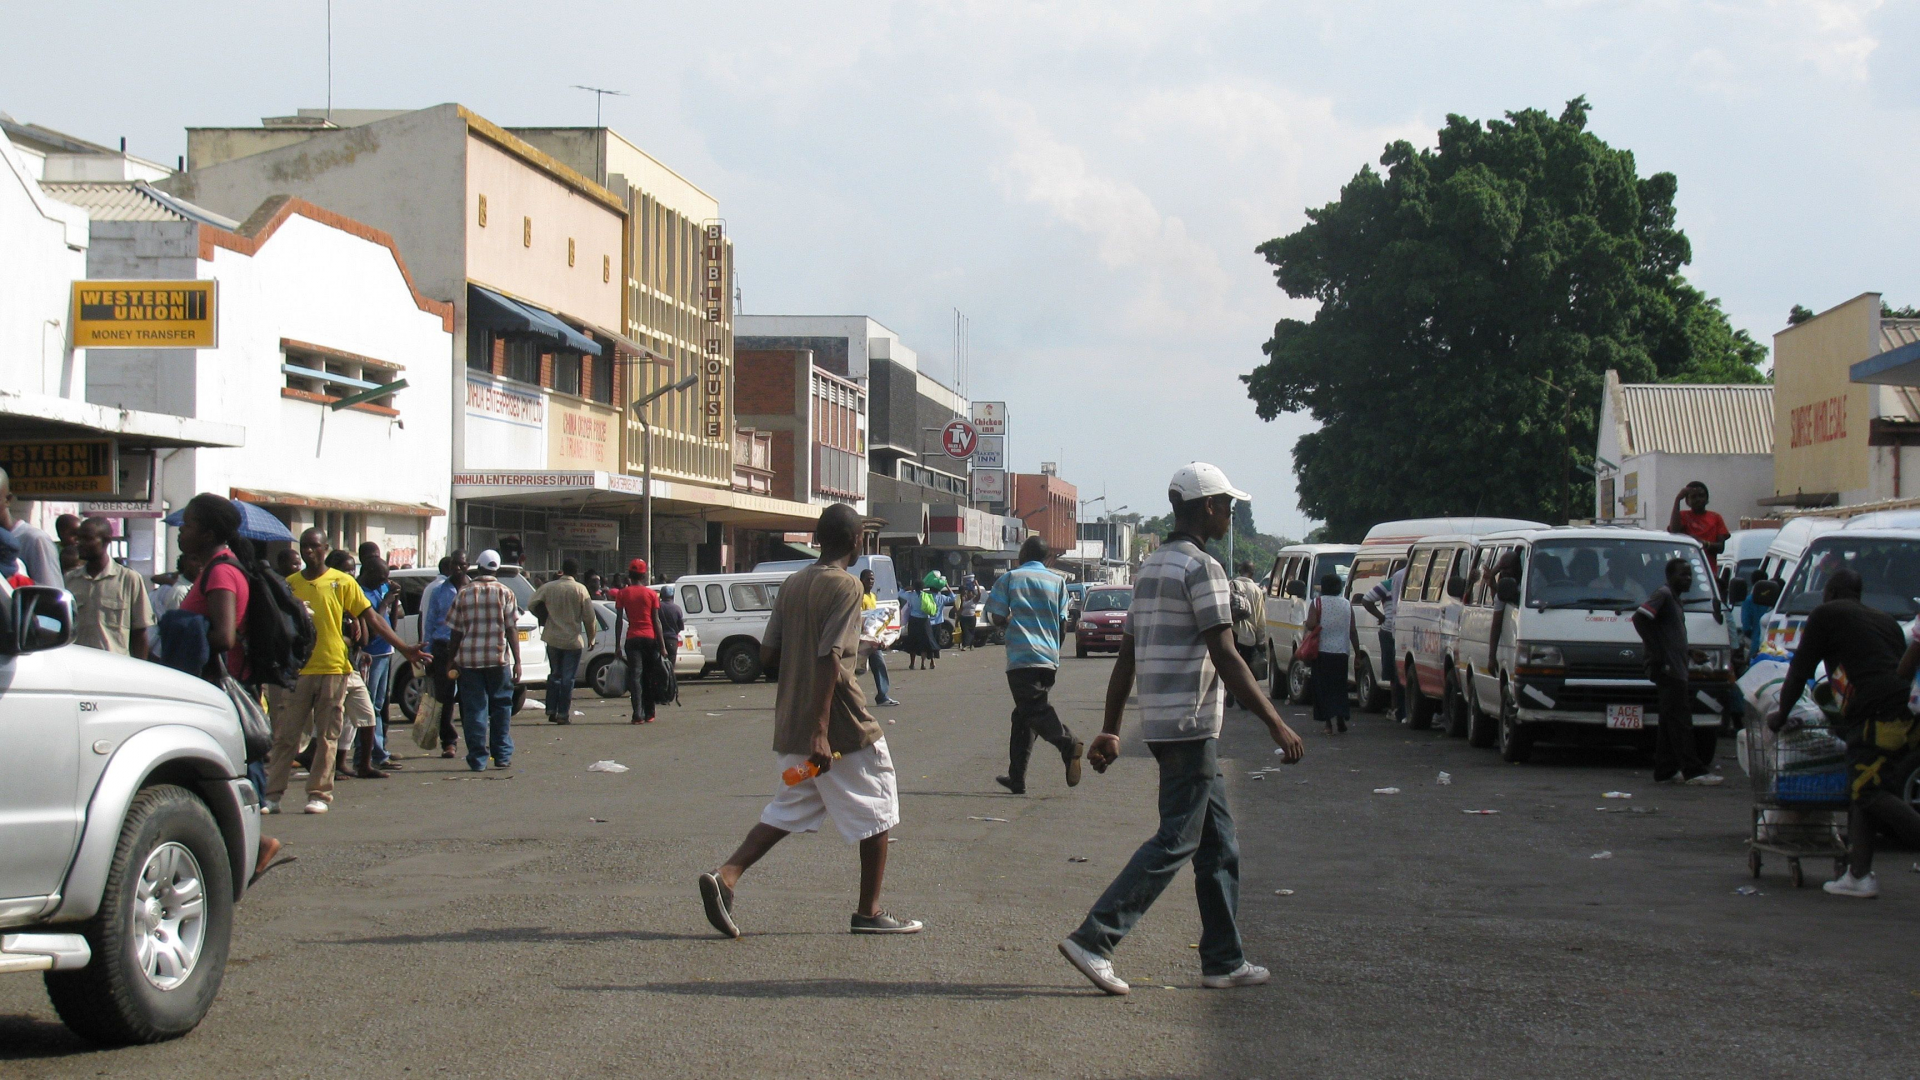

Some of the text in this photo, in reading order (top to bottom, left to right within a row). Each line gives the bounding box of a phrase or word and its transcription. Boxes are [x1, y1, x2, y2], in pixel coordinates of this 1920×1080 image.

[82, 291, 184, 305] WESTERN
[114, 306, 184, 320] UNION
[91, 330, 196, 339] MONEY TRANSFER
[707, 226, 720, 436] BIBLE HOUSE
[485, 388, 520, 417] ENTERPRISES
[974, 418, 1002, 426] Chicken
[948, 425, 973, 450] TV
[12, 461, 88, 478] UNION
[33, 480, 98, 490] TRANSFER
[452, 474, 595, 486] JINHUA ENTERPRISES (PVT) LTD
[89, 502, 152, 511] CYBER-CAFE
[79, 701, 99, 712] SDX
[1617, 706, 1639, 717] ACE
[1612, 717, 1640, 729] 7478
